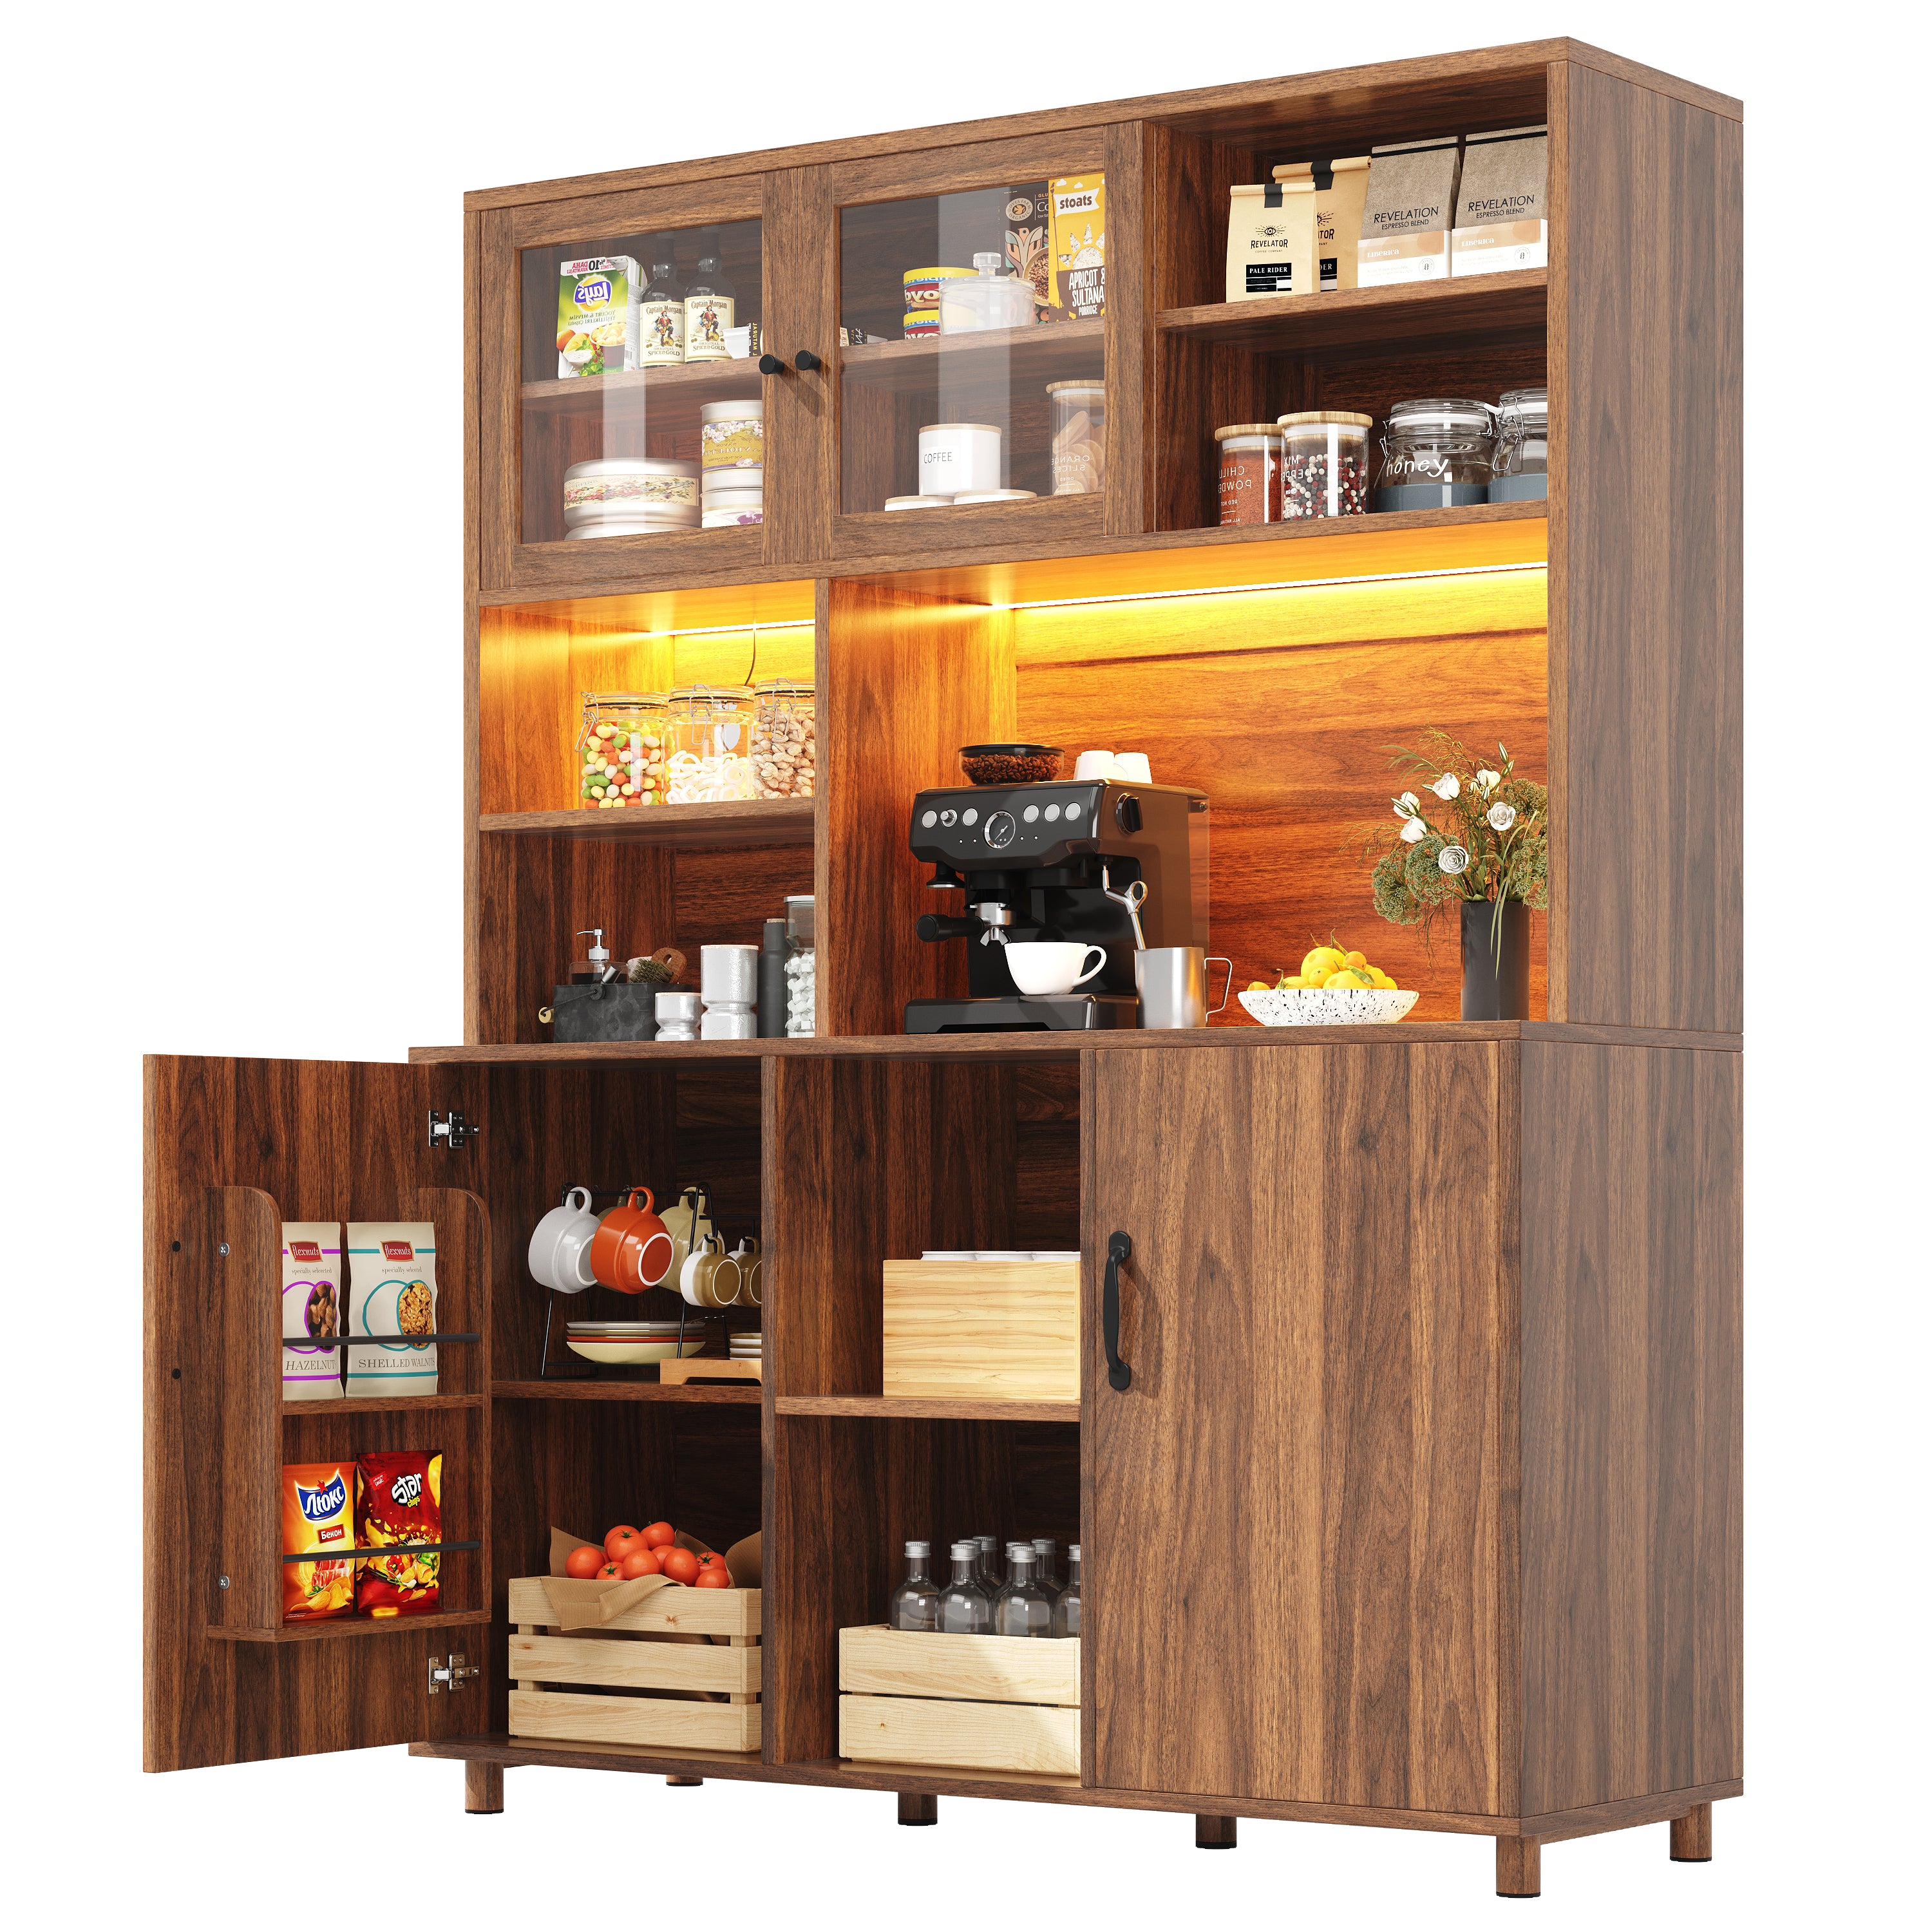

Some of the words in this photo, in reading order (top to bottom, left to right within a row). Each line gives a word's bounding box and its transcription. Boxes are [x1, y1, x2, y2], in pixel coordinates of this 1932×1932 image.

[1059, 194, 1092, 209] stoats
[1468, 194, 1535, 212] REVELATION
[1374, 206, 1439, 223] REVELATION
[1476, 209, 1504, 219] ESPRESSO
[1381, 221, 1409, 230] ESPRESSO
[1251, 239, 1288, 249] REVELATOR
[1068, 269, 1098, 290] APRICOT
[1072, 285, 1104, 307] SULTANA
[646, 306, 663, 315] Captain
[663, 305, 682, 315] Morgan
[691, 300, 708, 309] Captain
[708, 299, 727, 309] Morgan
[1079, 305, 1097, 316] PORRIDGE
[923, 452, 952, 464] COFFEE
[1387, 459, 1449, 477] honey
[292, 1244, 319, 1258] flexnuts
[384, 1244, 412, 1258] flexnuts
[291, 1267, 311, 1275] specially
[381, 1266, 405, 1274] specially
[359, 1358, 410, 1368] SHELLED
[411, 1357, 435, 1367] WALNUTS
[303, 1486, 345, 1515] Люкс
[407, 1496, 421, 1508] chips
[321, 1528, 342, 1540] Бекон
